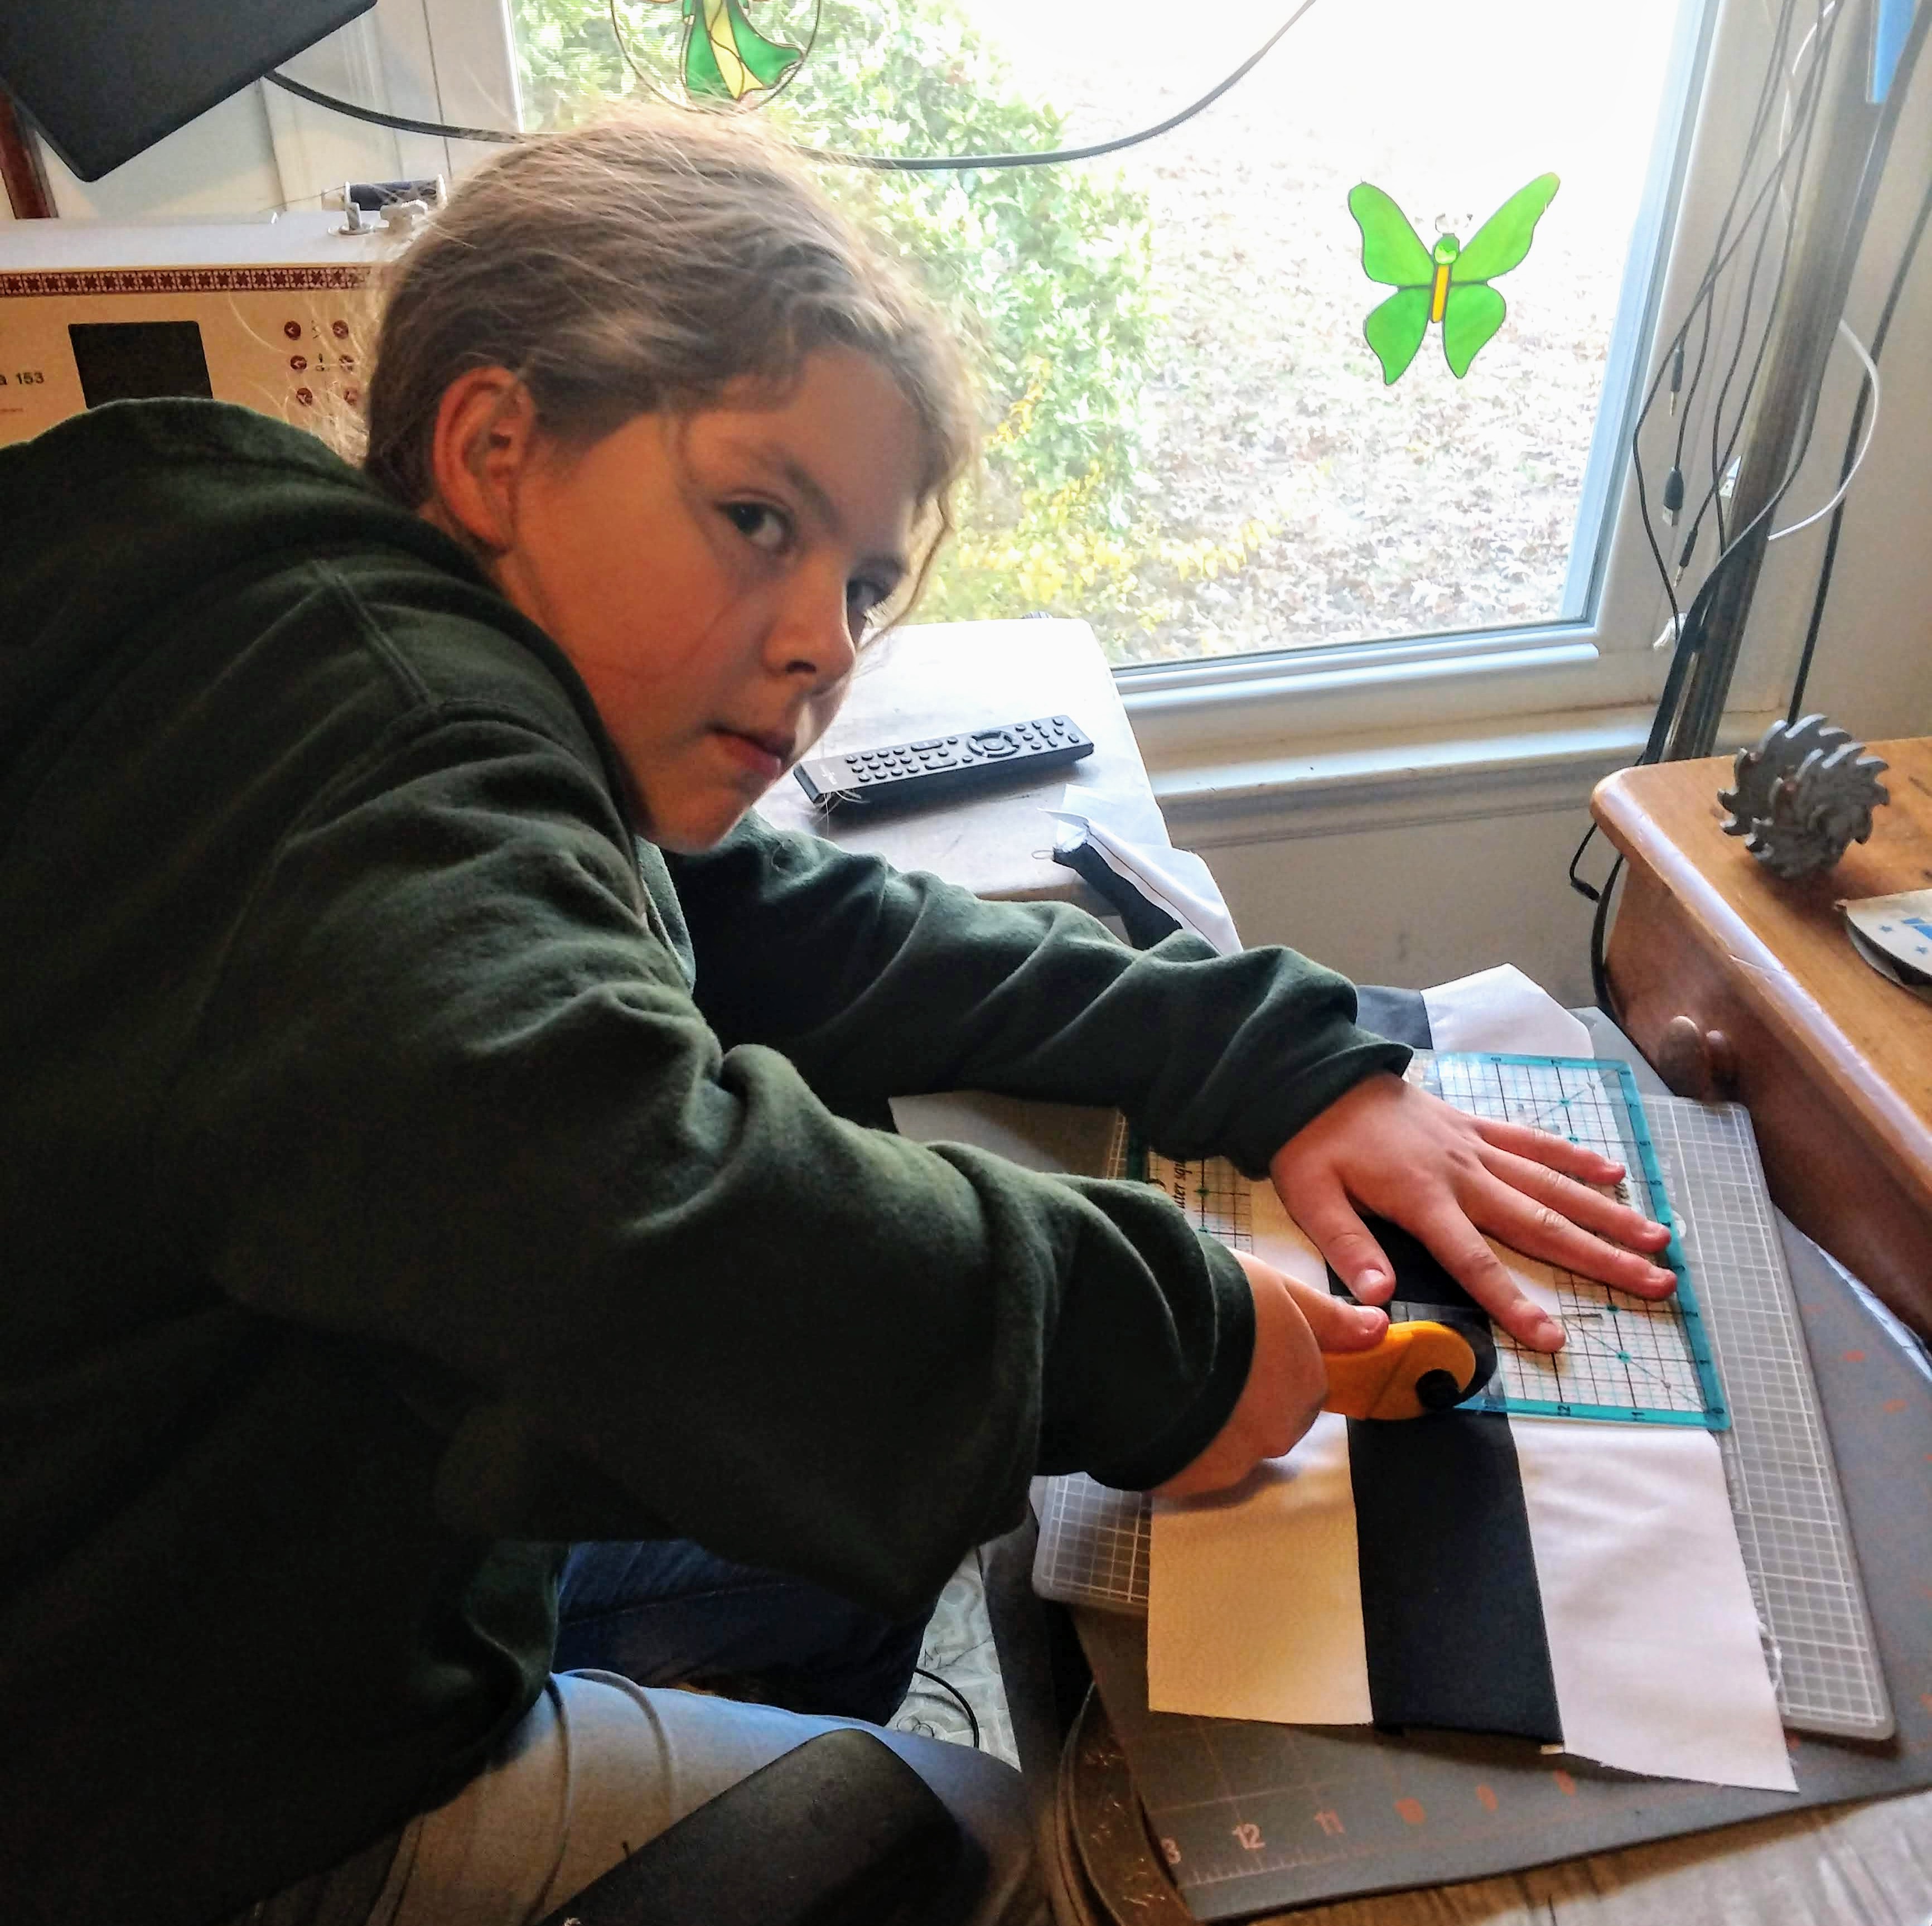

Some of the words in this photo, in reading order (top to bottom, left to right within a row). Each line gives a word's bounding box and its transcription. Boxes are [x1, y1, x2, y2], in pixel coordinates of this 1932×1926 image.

[16, 371, 45, 385] 153
[1173, 1161, 1192, 1181] squ
[1161, 1838, 1181, 1864] 3
[1231, 1823, 1266, 1850] 12
